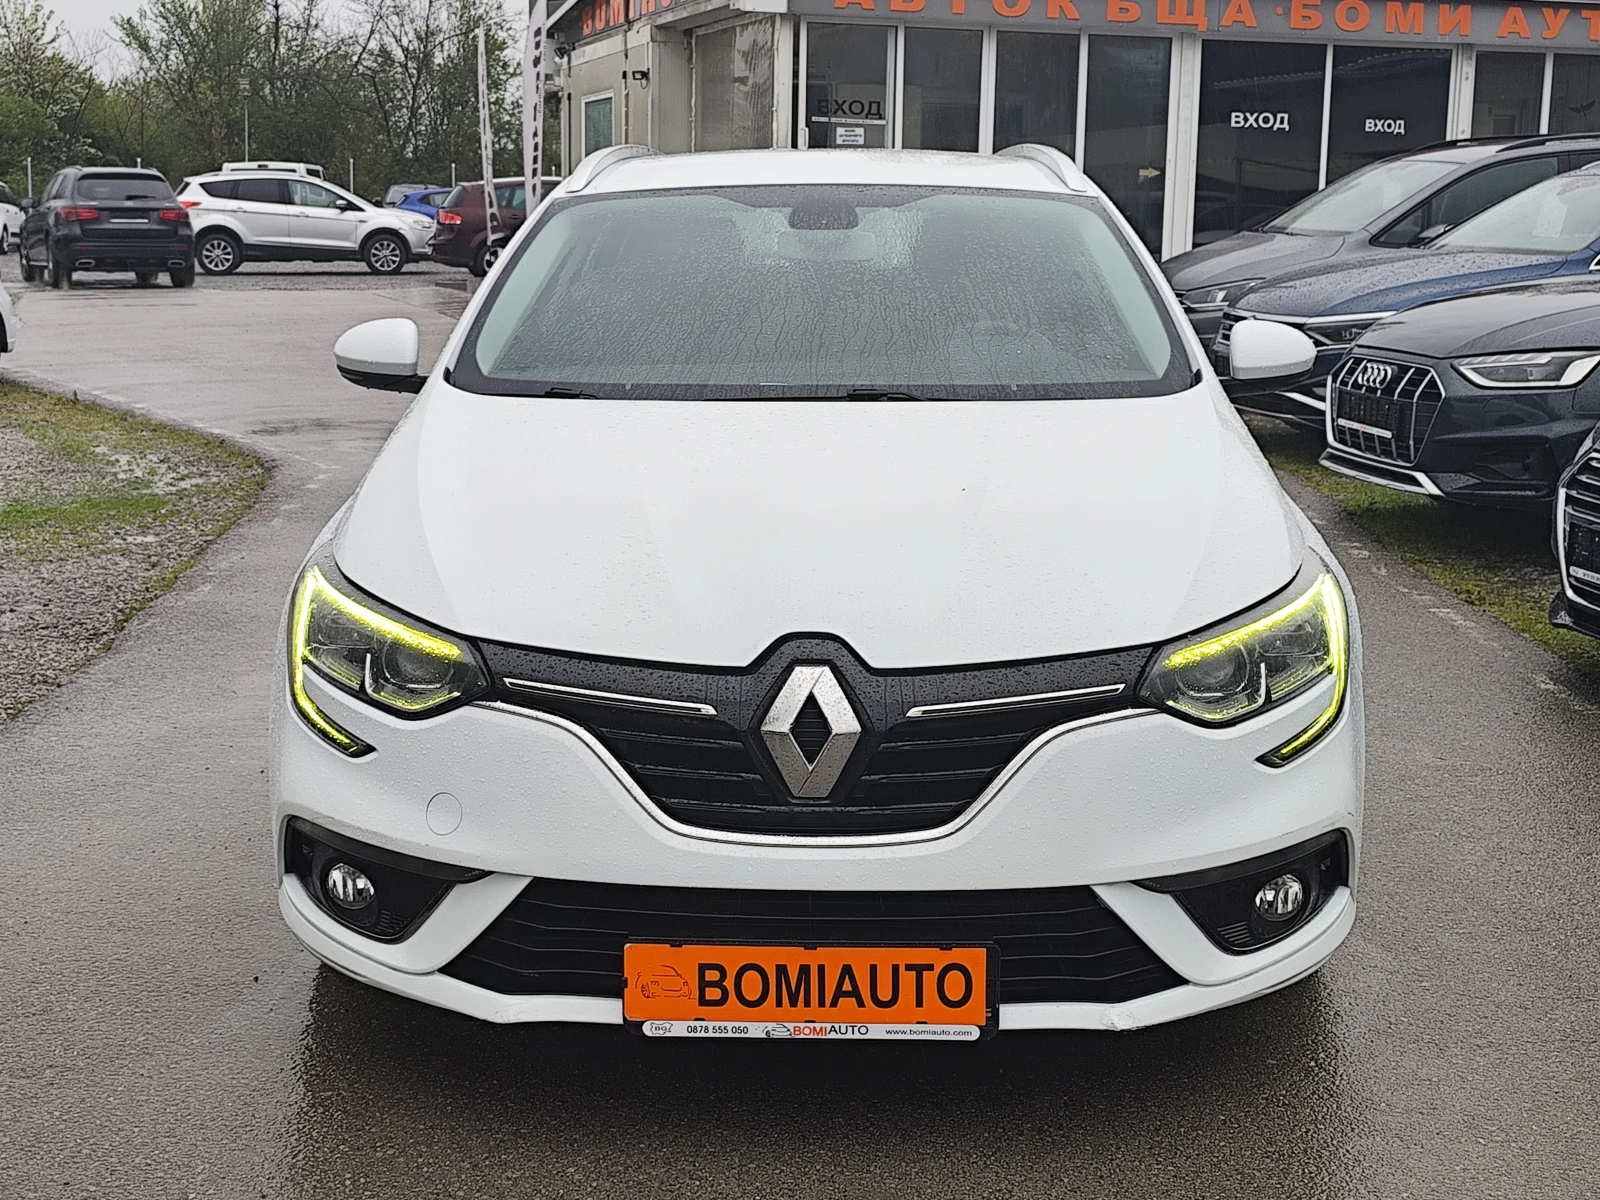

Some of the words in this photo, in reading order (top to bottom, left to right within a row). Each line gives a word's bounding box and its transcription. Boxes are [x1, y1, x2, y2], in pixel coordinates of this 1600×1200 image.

[1289, 0, 1472, 36] БОМИ
[817, 99, 882, 119] ВХОД
[1230, 111, 1290, 132] ВХОД
[1364, 118, 1405, 135] ВХОД
[696, 962, 974, 1010] BOMIAUTO
[686, 1025, 710, 1034] 0878
[711, 1025, 729, 1034] 555
[730, 1025, 749, 1035] 050
[885, 1028, 973, 1037] www.bomiauto.com
